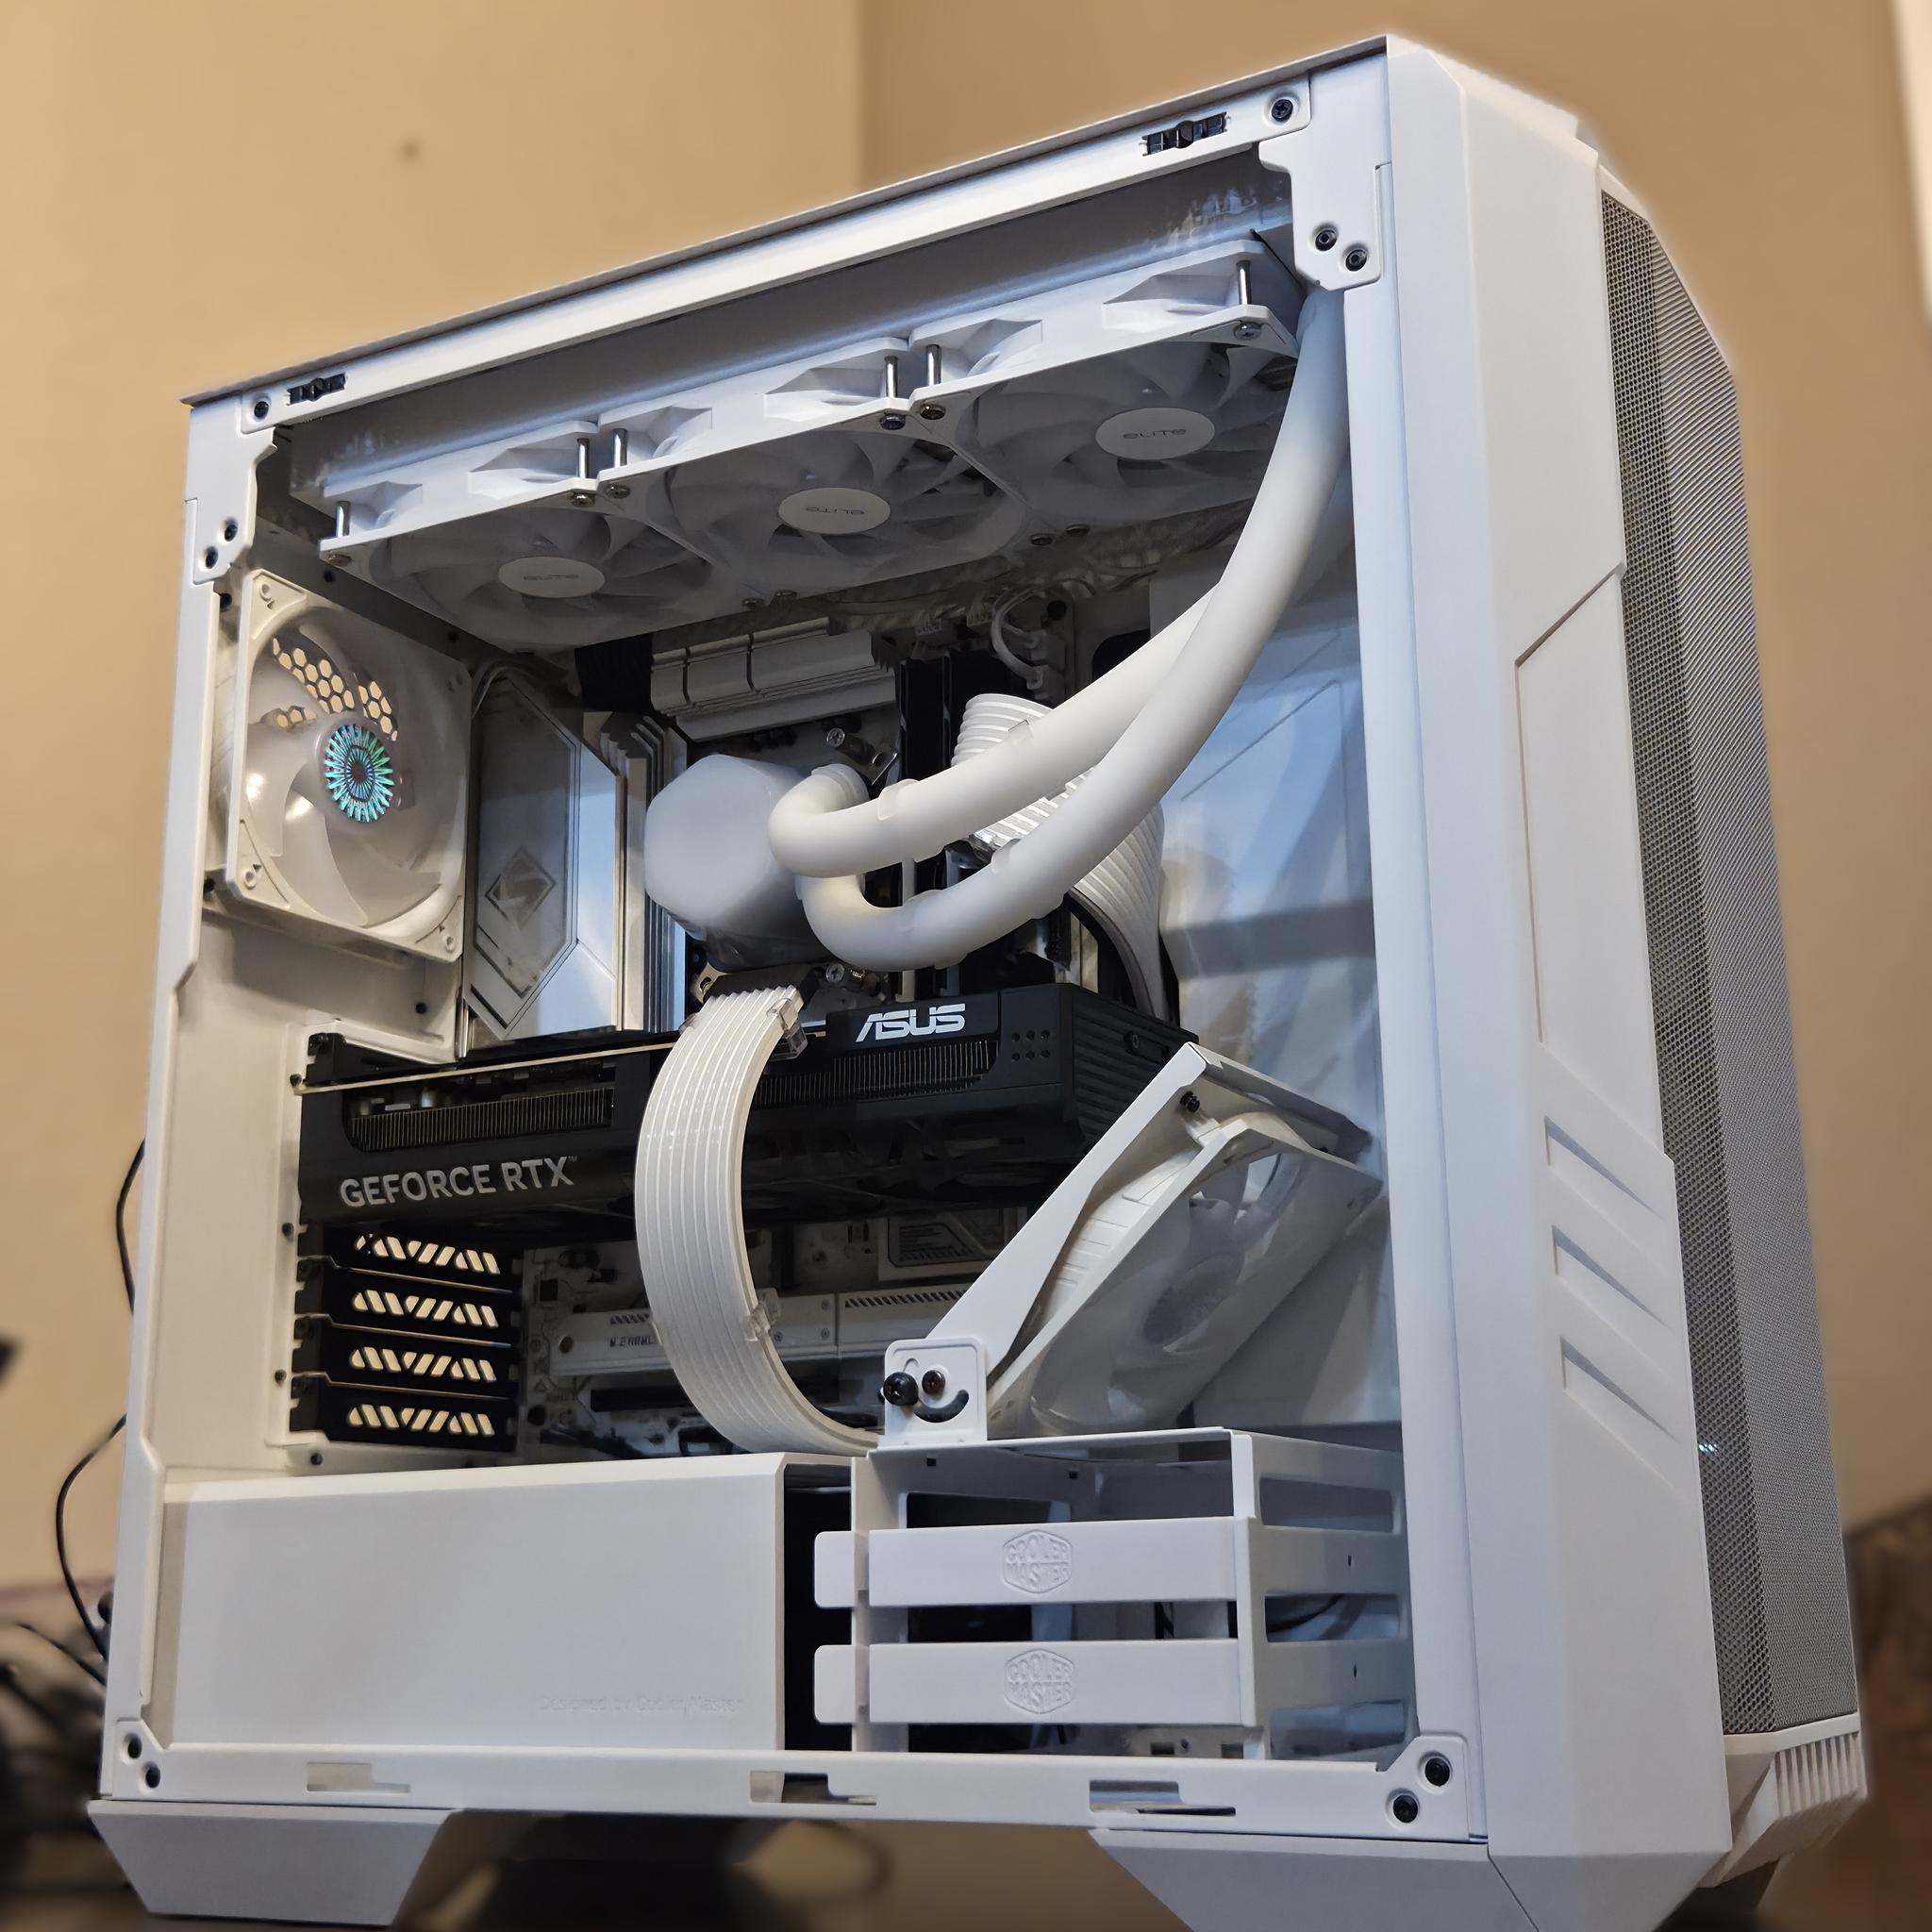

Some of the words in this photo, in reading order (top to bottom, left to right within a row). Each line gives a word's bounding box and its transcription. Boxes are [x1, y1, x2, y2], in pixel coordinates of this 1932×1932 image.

[855, 1003, 967, 1043] ASUS
[339, 1163, 497, 1208] GEFORCE
[1006, 1534, 1069, 1562] COOLER
[1006, 1561, 1070, 1588] MASTER
[1008, 1653, 1072, 1681] COOLER
[1008, 1681, 1073, 1707] MASTER
